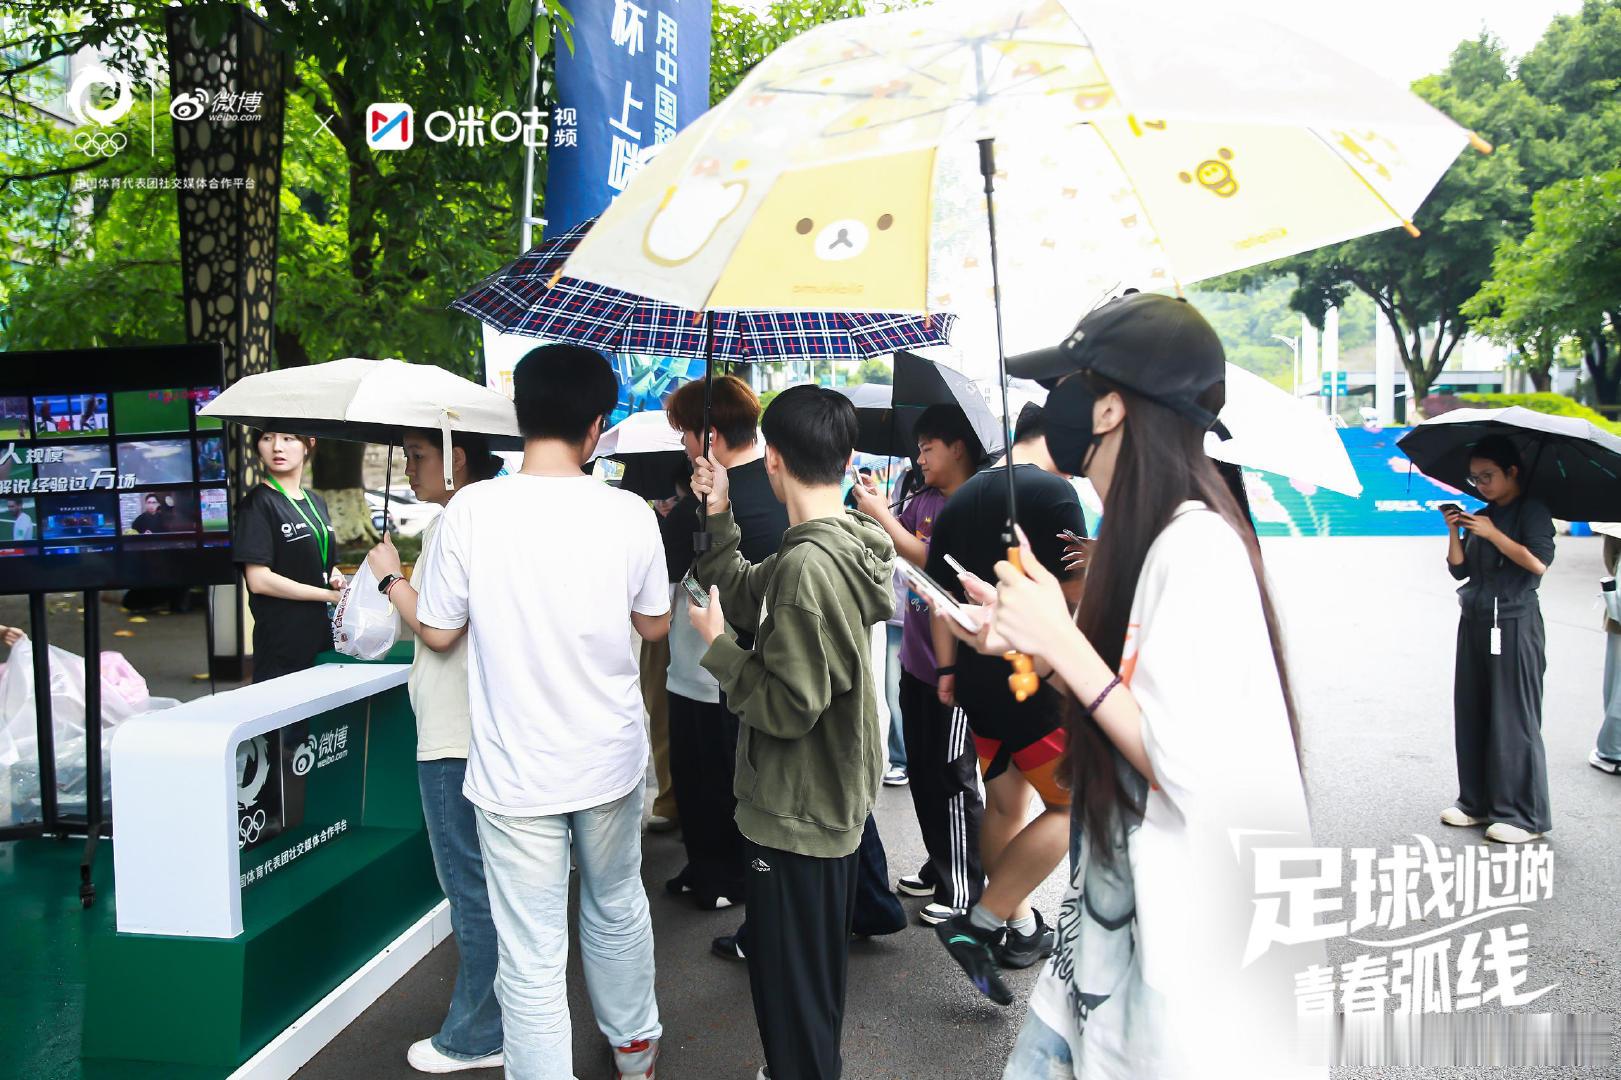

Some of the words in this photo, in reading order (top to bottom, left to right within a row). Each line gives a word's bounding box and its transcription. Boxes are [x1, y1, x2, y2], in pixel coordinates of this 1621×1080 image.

[611, 0, 648, 57] 杯
[0, 442, 65, 465] 人规模
[0, 467, 137, 495] 解说经验过万场
[319, 725, 349, 759] 微博
[316, 749, 348, 769] weibo.com
